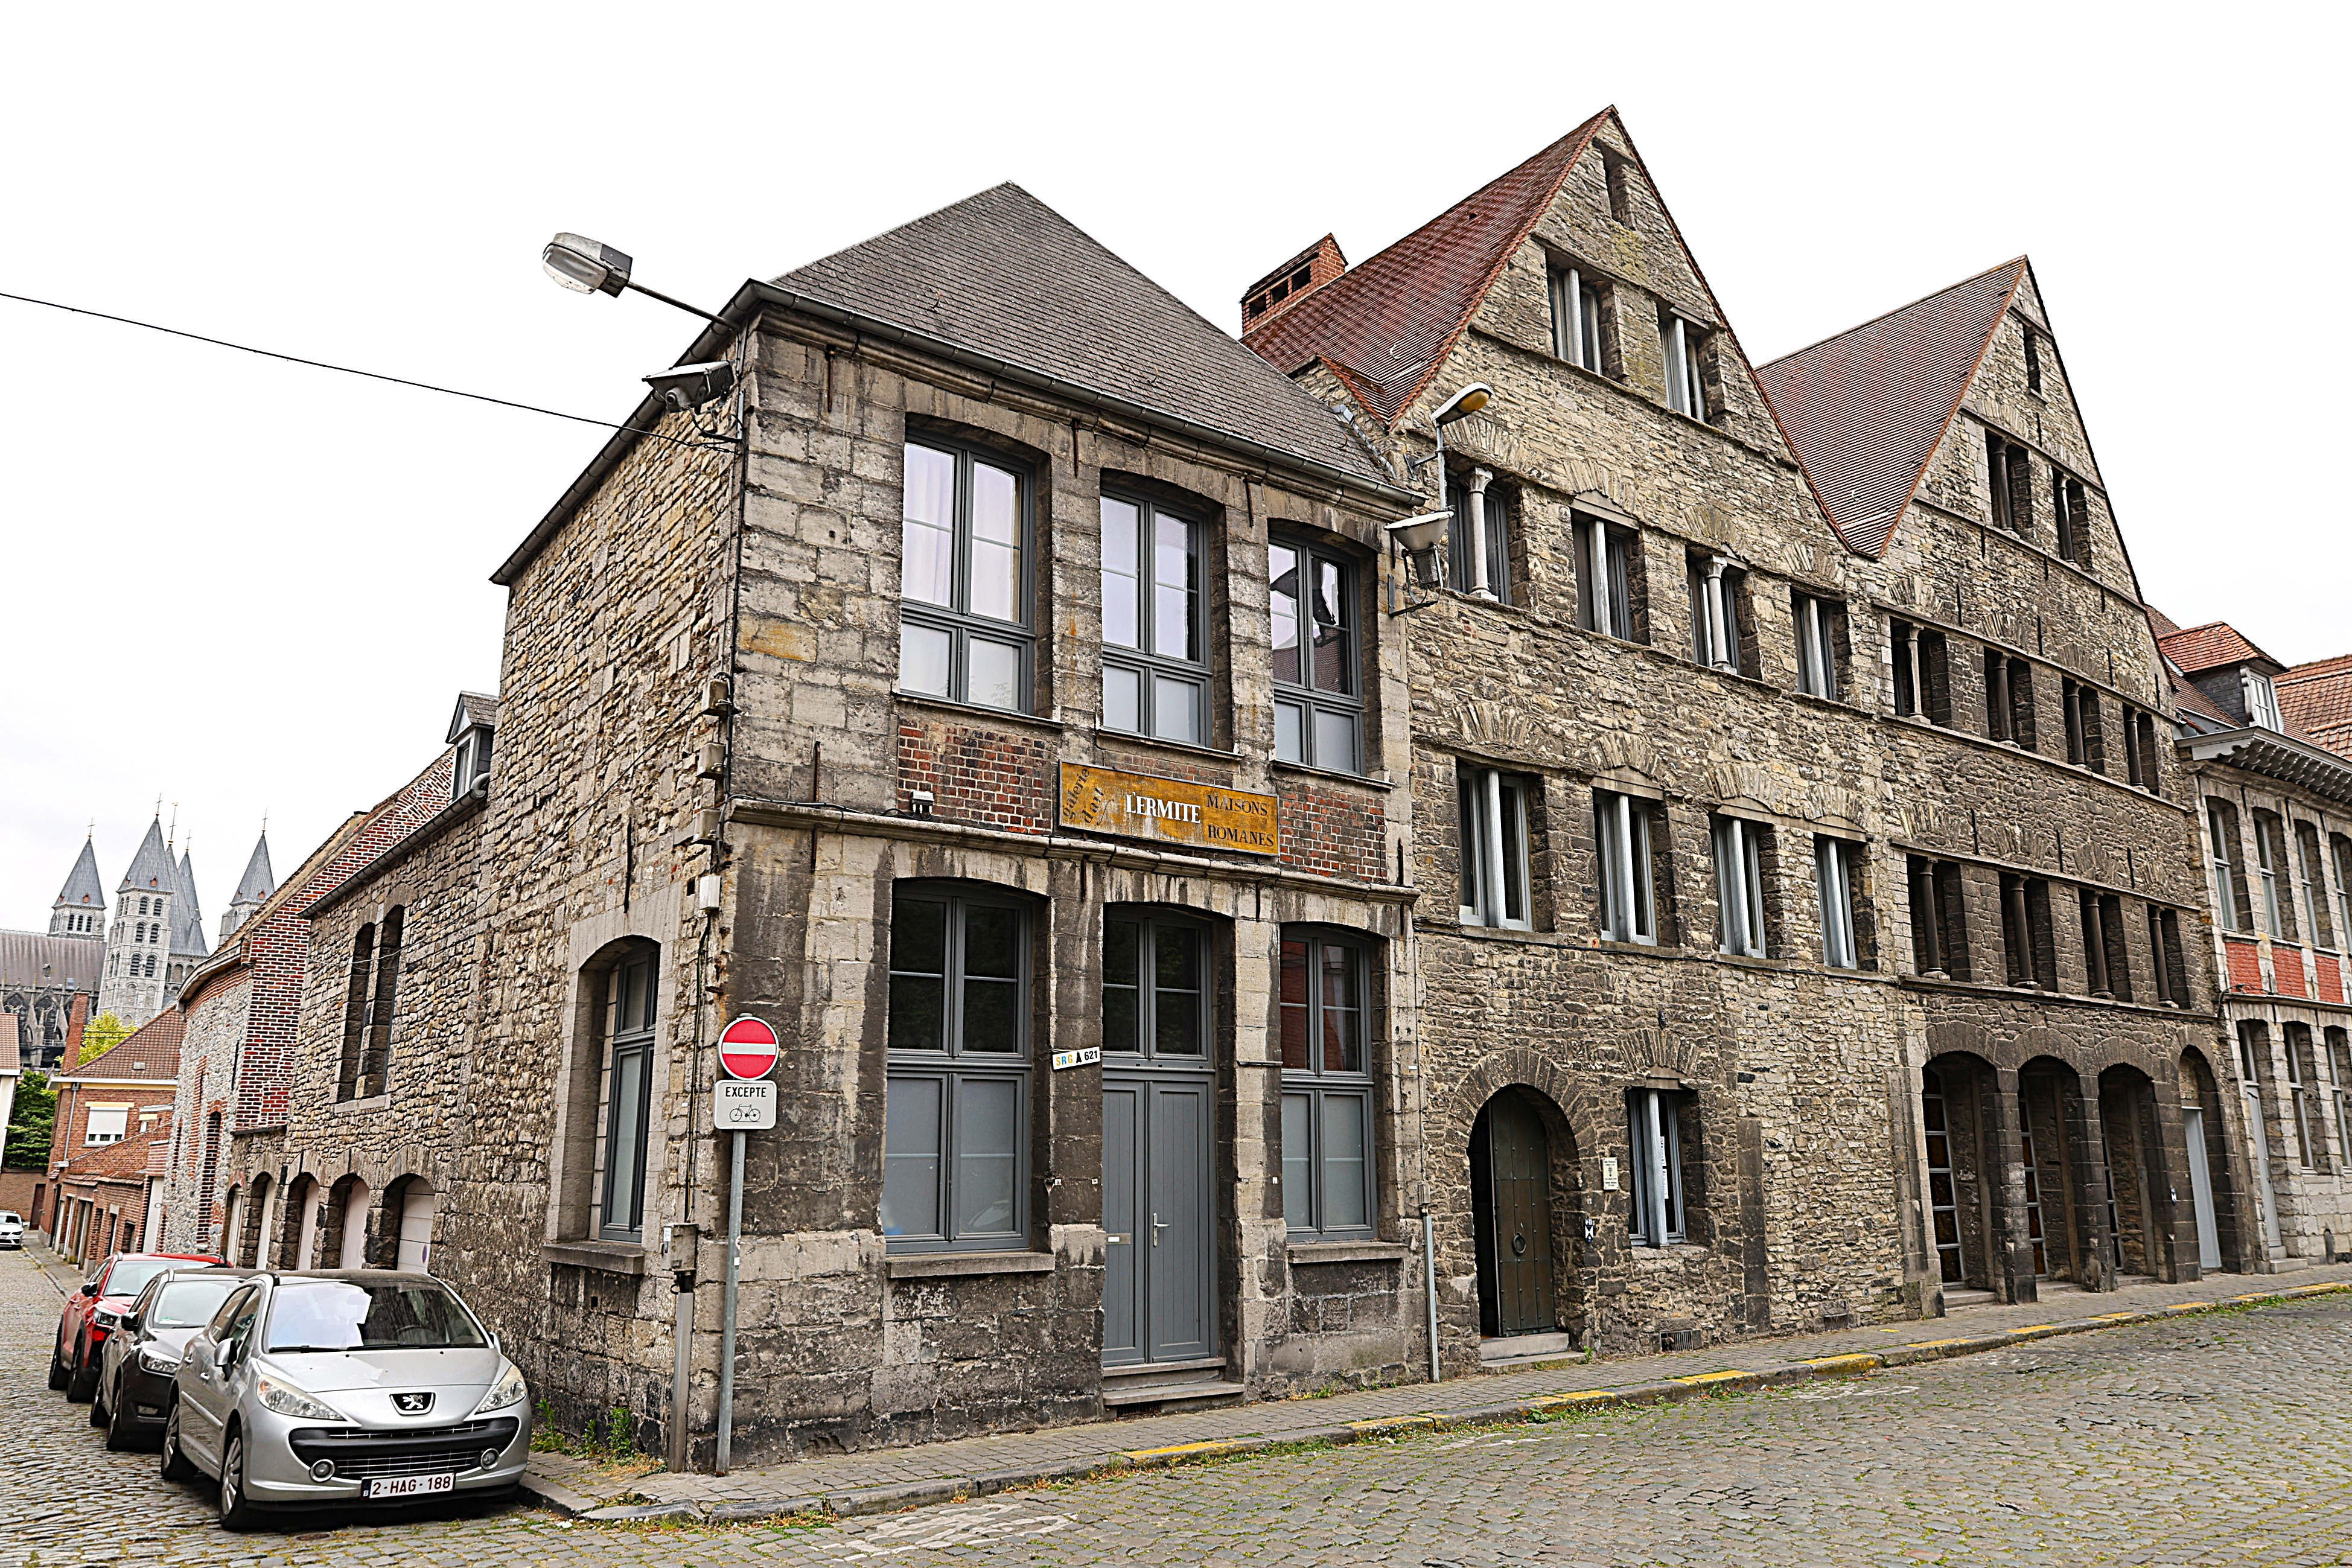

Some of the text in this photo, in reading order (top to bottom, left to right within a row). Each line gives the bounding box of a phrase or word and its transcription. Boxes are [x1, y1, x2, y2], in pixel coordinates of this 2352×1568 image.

[1062, 768, 1089, 821] galerie
[1207, 794, 1267, 816] MAISONS
[1126, 791, 1200, 824] L'ERMITE
[1208, 824, 1274, 847] ROMANES
[1056, 1050, 1098, 1066] SRG 621
[725, 1087, 766, 1097] EXCEPTE
